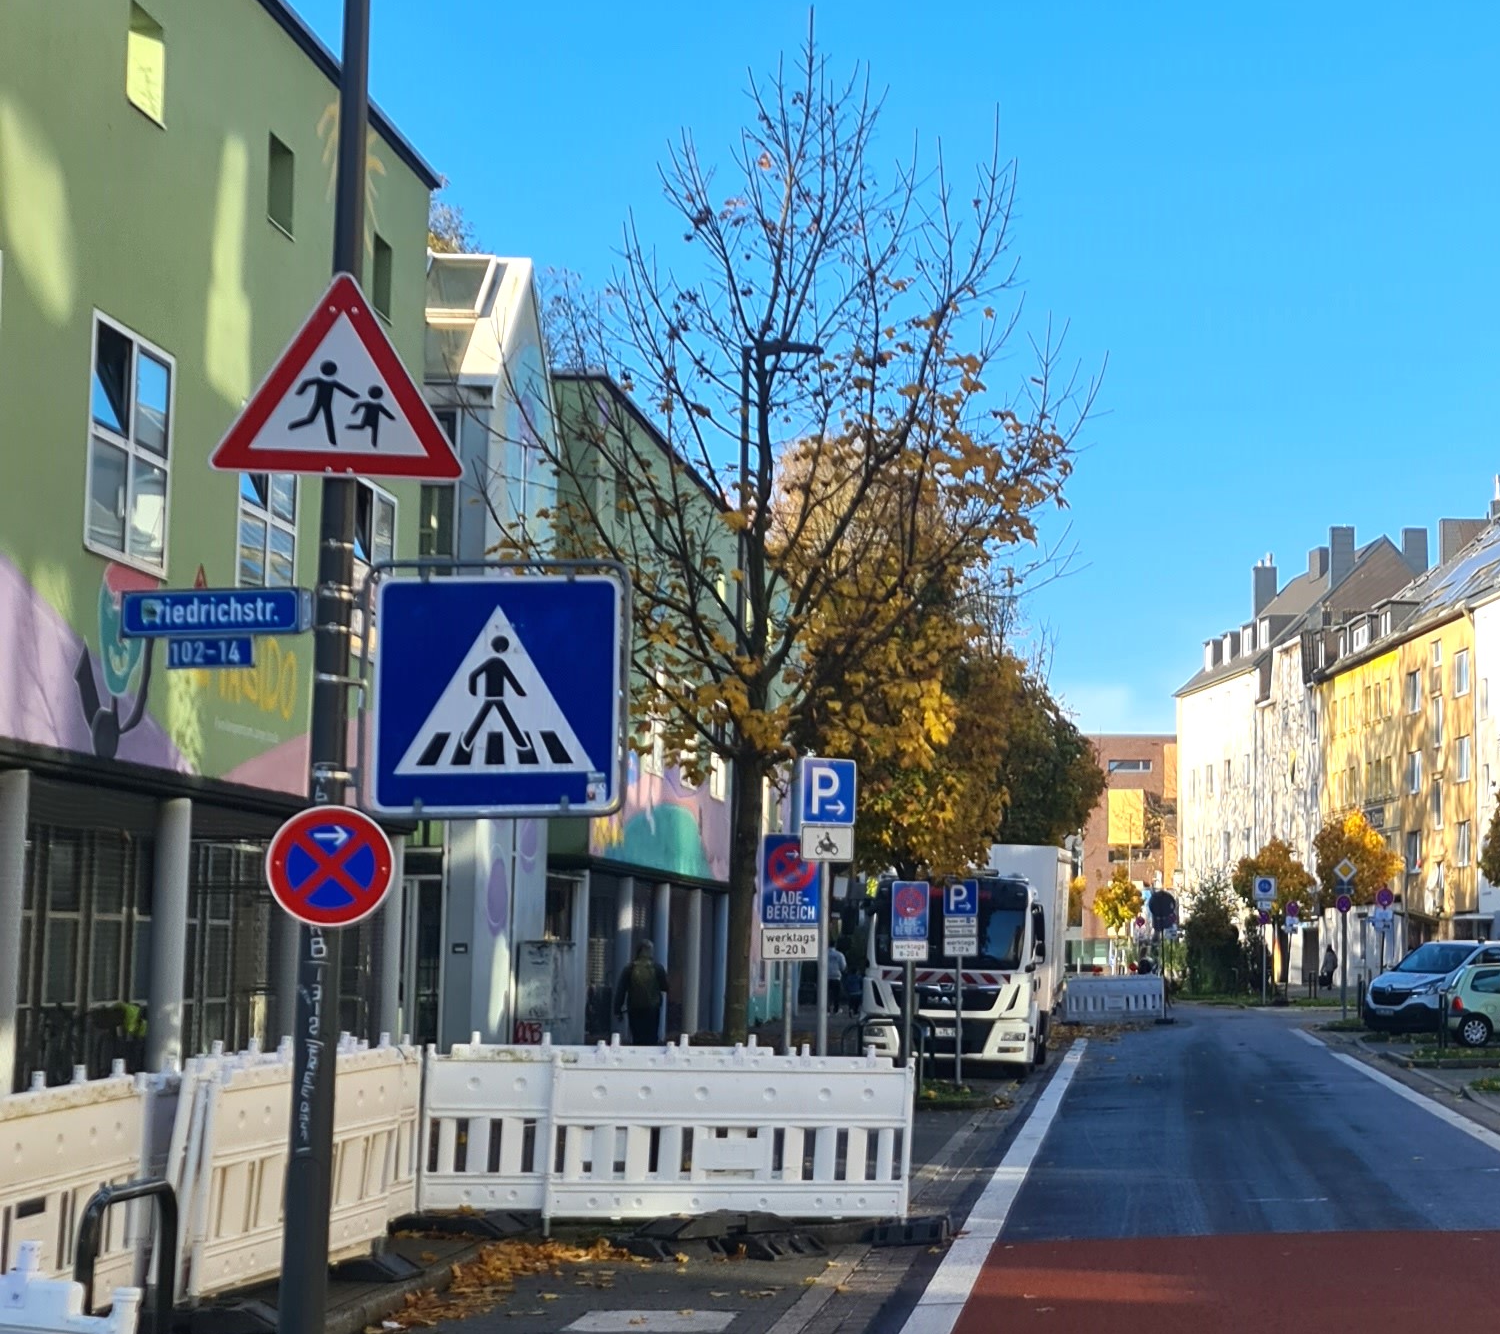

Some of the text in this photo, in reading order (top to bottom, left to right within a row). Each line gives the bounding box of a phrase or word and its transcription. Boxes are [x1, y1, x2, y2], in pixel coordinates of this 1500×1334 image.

[141, 597, 279, 625] riedrichstr.
[171, 639, 241, 664] 102-14
[811, 767, 840, 814] P
[772, 891, 810, 905] LADE-
[950, 884, 968, 912] P
[766, 905, 816, 920] BEREICH
[766, 930, 816, 944] werktags
[773, 944, 800, 955] 8-20
